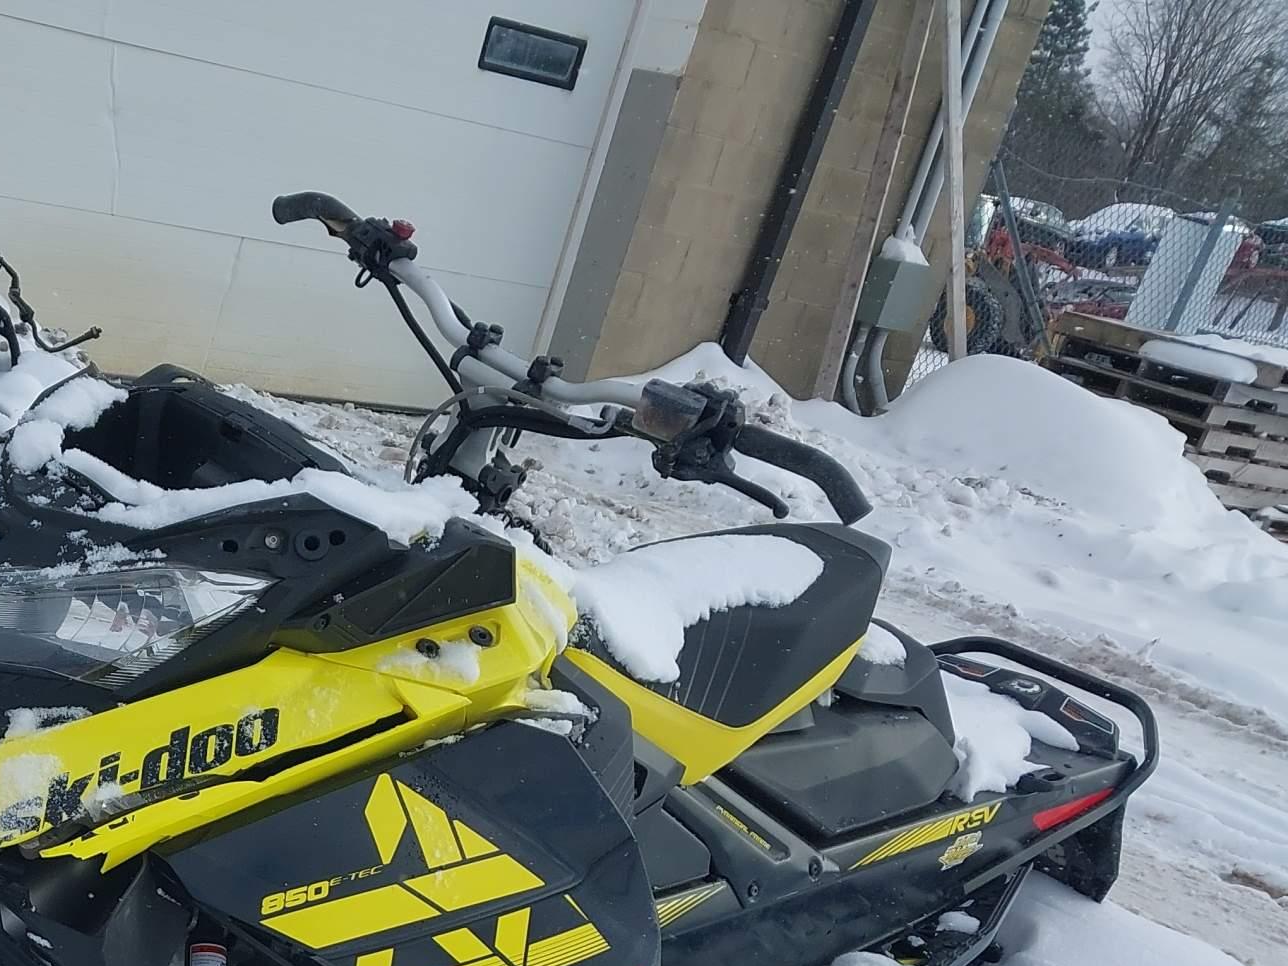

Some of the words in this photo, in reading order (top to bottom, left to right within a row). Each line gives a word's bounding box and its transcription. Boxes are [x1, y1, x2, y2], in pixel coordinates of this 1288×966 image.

[949, 802, 1002, 835] REV
[261, 880, 330, 915] 850
[329, 864, 384, 887] E-TEC
